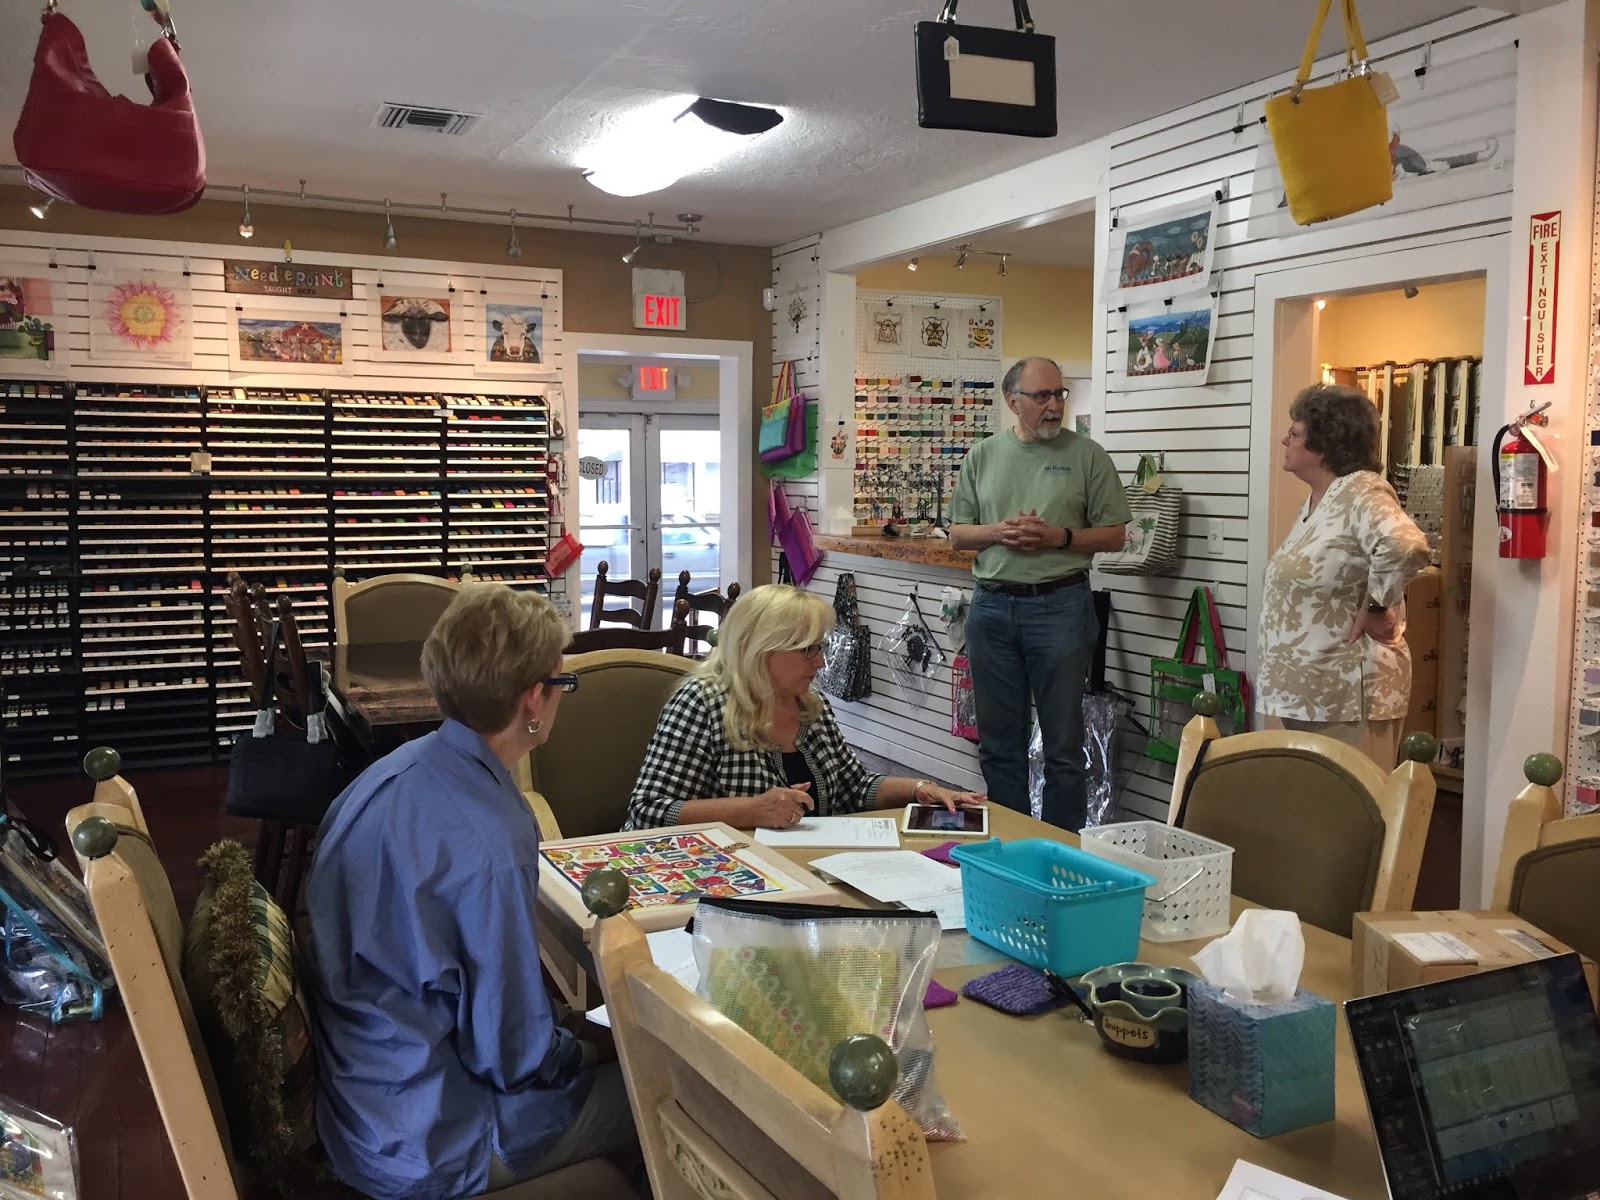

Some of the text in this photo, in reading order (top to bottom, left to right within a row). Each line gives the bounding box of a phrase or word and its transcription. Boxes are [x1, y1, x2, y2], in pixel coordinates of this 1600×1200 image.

[1533, 222, 1558, 240] FIRE
[263, 285, 293, 294] TAUGHT
[644, 295, 680, 327] EXIT
[1535, 241, 1548, 377] EXTINGUISHER
[640, 366, 668, 391] EXIT
